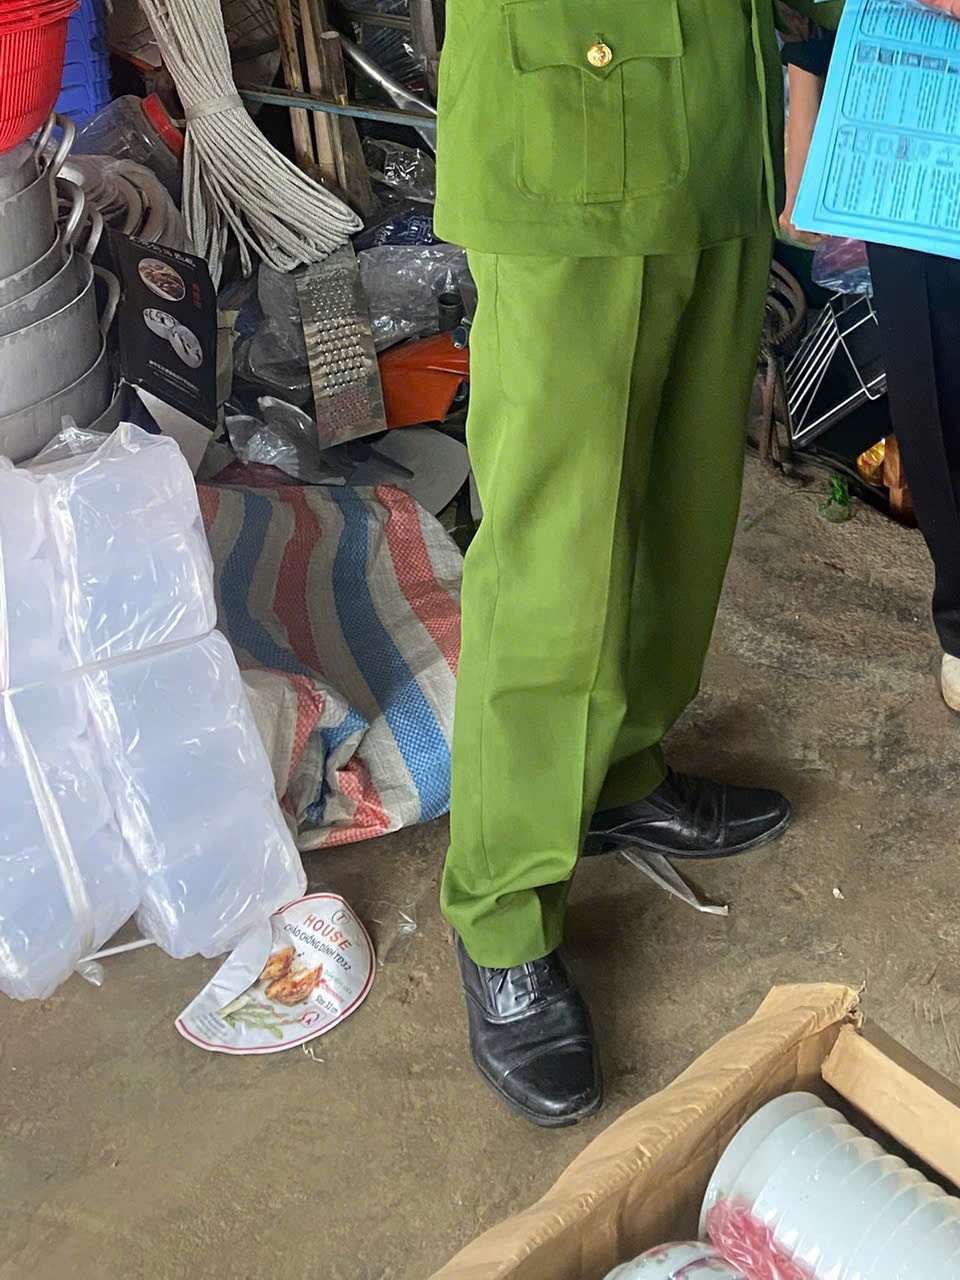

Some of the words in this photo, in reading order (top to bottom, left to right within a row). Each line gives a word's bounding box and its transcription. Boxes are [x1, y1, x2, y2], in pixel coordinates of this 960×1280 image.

[299, 932, 321, 949] CHỐNG
[319, 943, 336, 957] DÍNH
[333, 953, 352, 971] TD32
[303, 914, 352, 951] HOUSE
